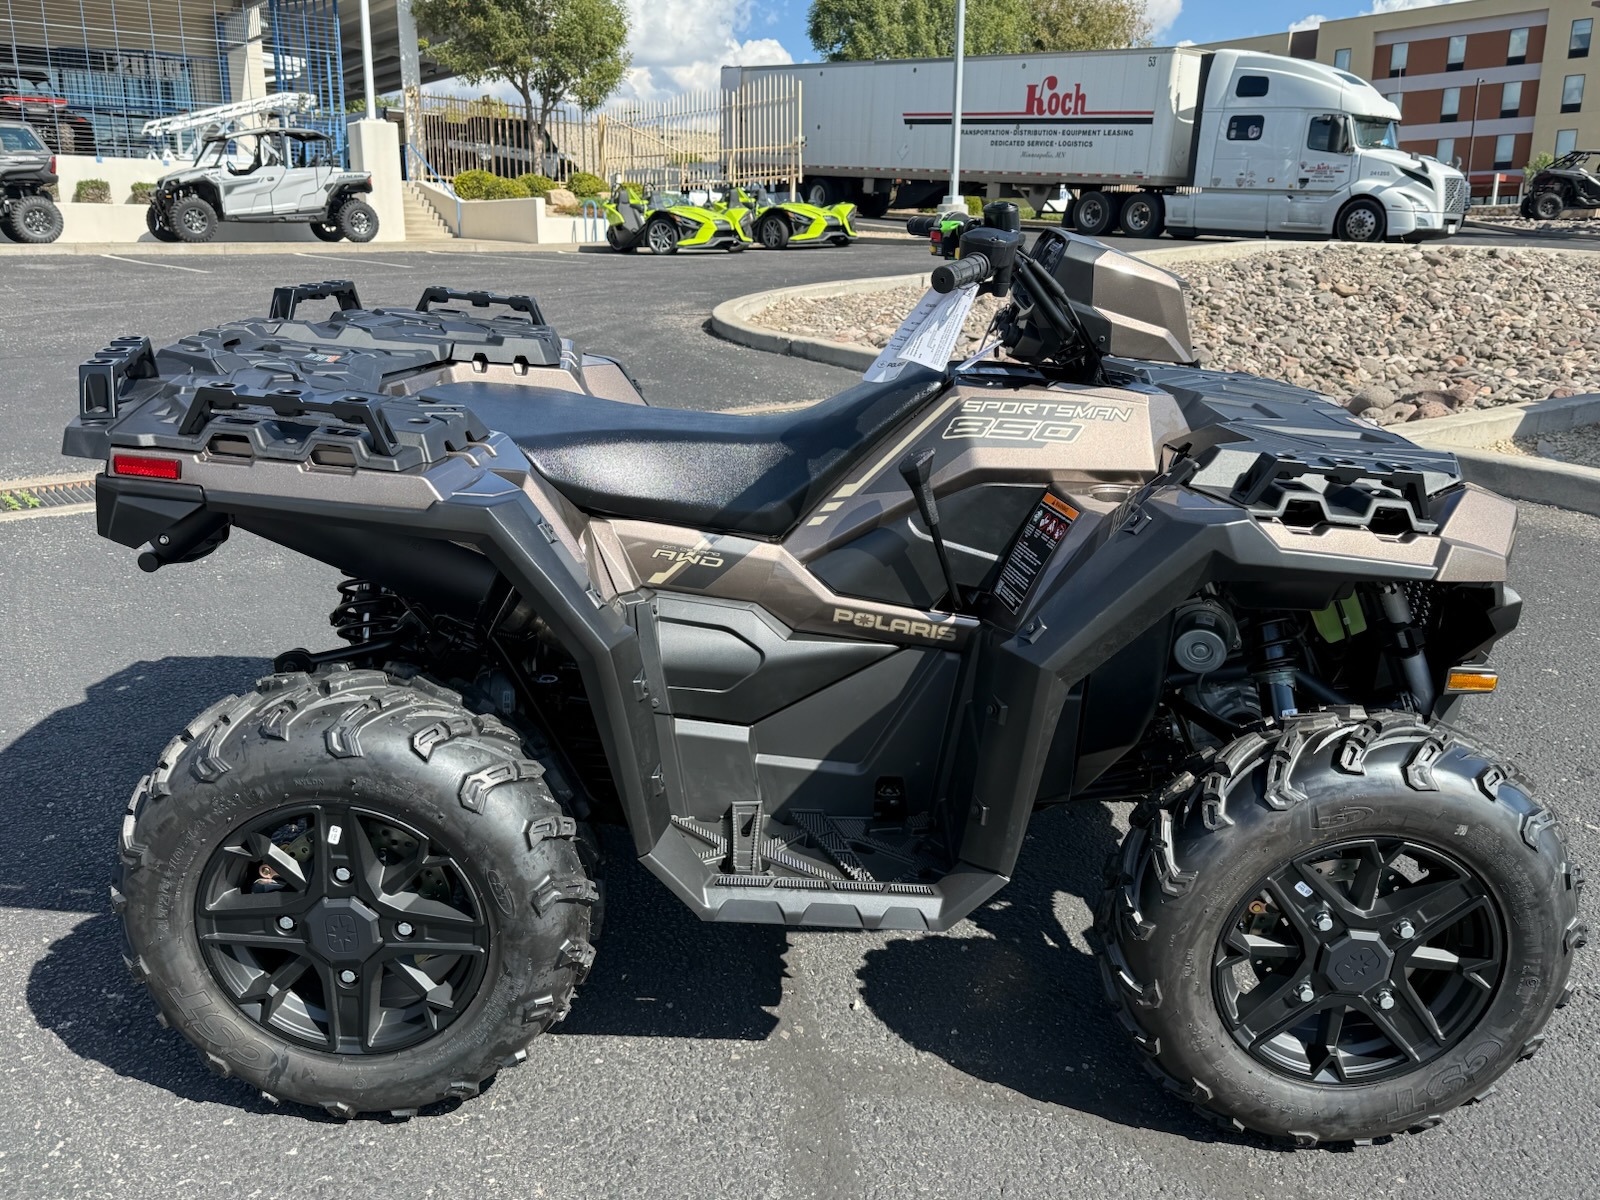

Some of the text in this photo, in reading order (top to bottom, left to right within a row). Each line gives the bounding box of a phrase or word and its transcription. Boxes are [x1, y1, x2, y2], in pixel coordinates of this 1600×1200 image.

[1025, 76, 1086, 116] Koch
[961, 400, 1133, 422] SPORTSMAN
[942, 416, 1085, 444] 850
[651, 548, 725, 568] AWD
[832, 607, 957, 642] POLARIS
[167, 986, 279, 1071] CST
[1386, 1040, 1502, 1124] CST
